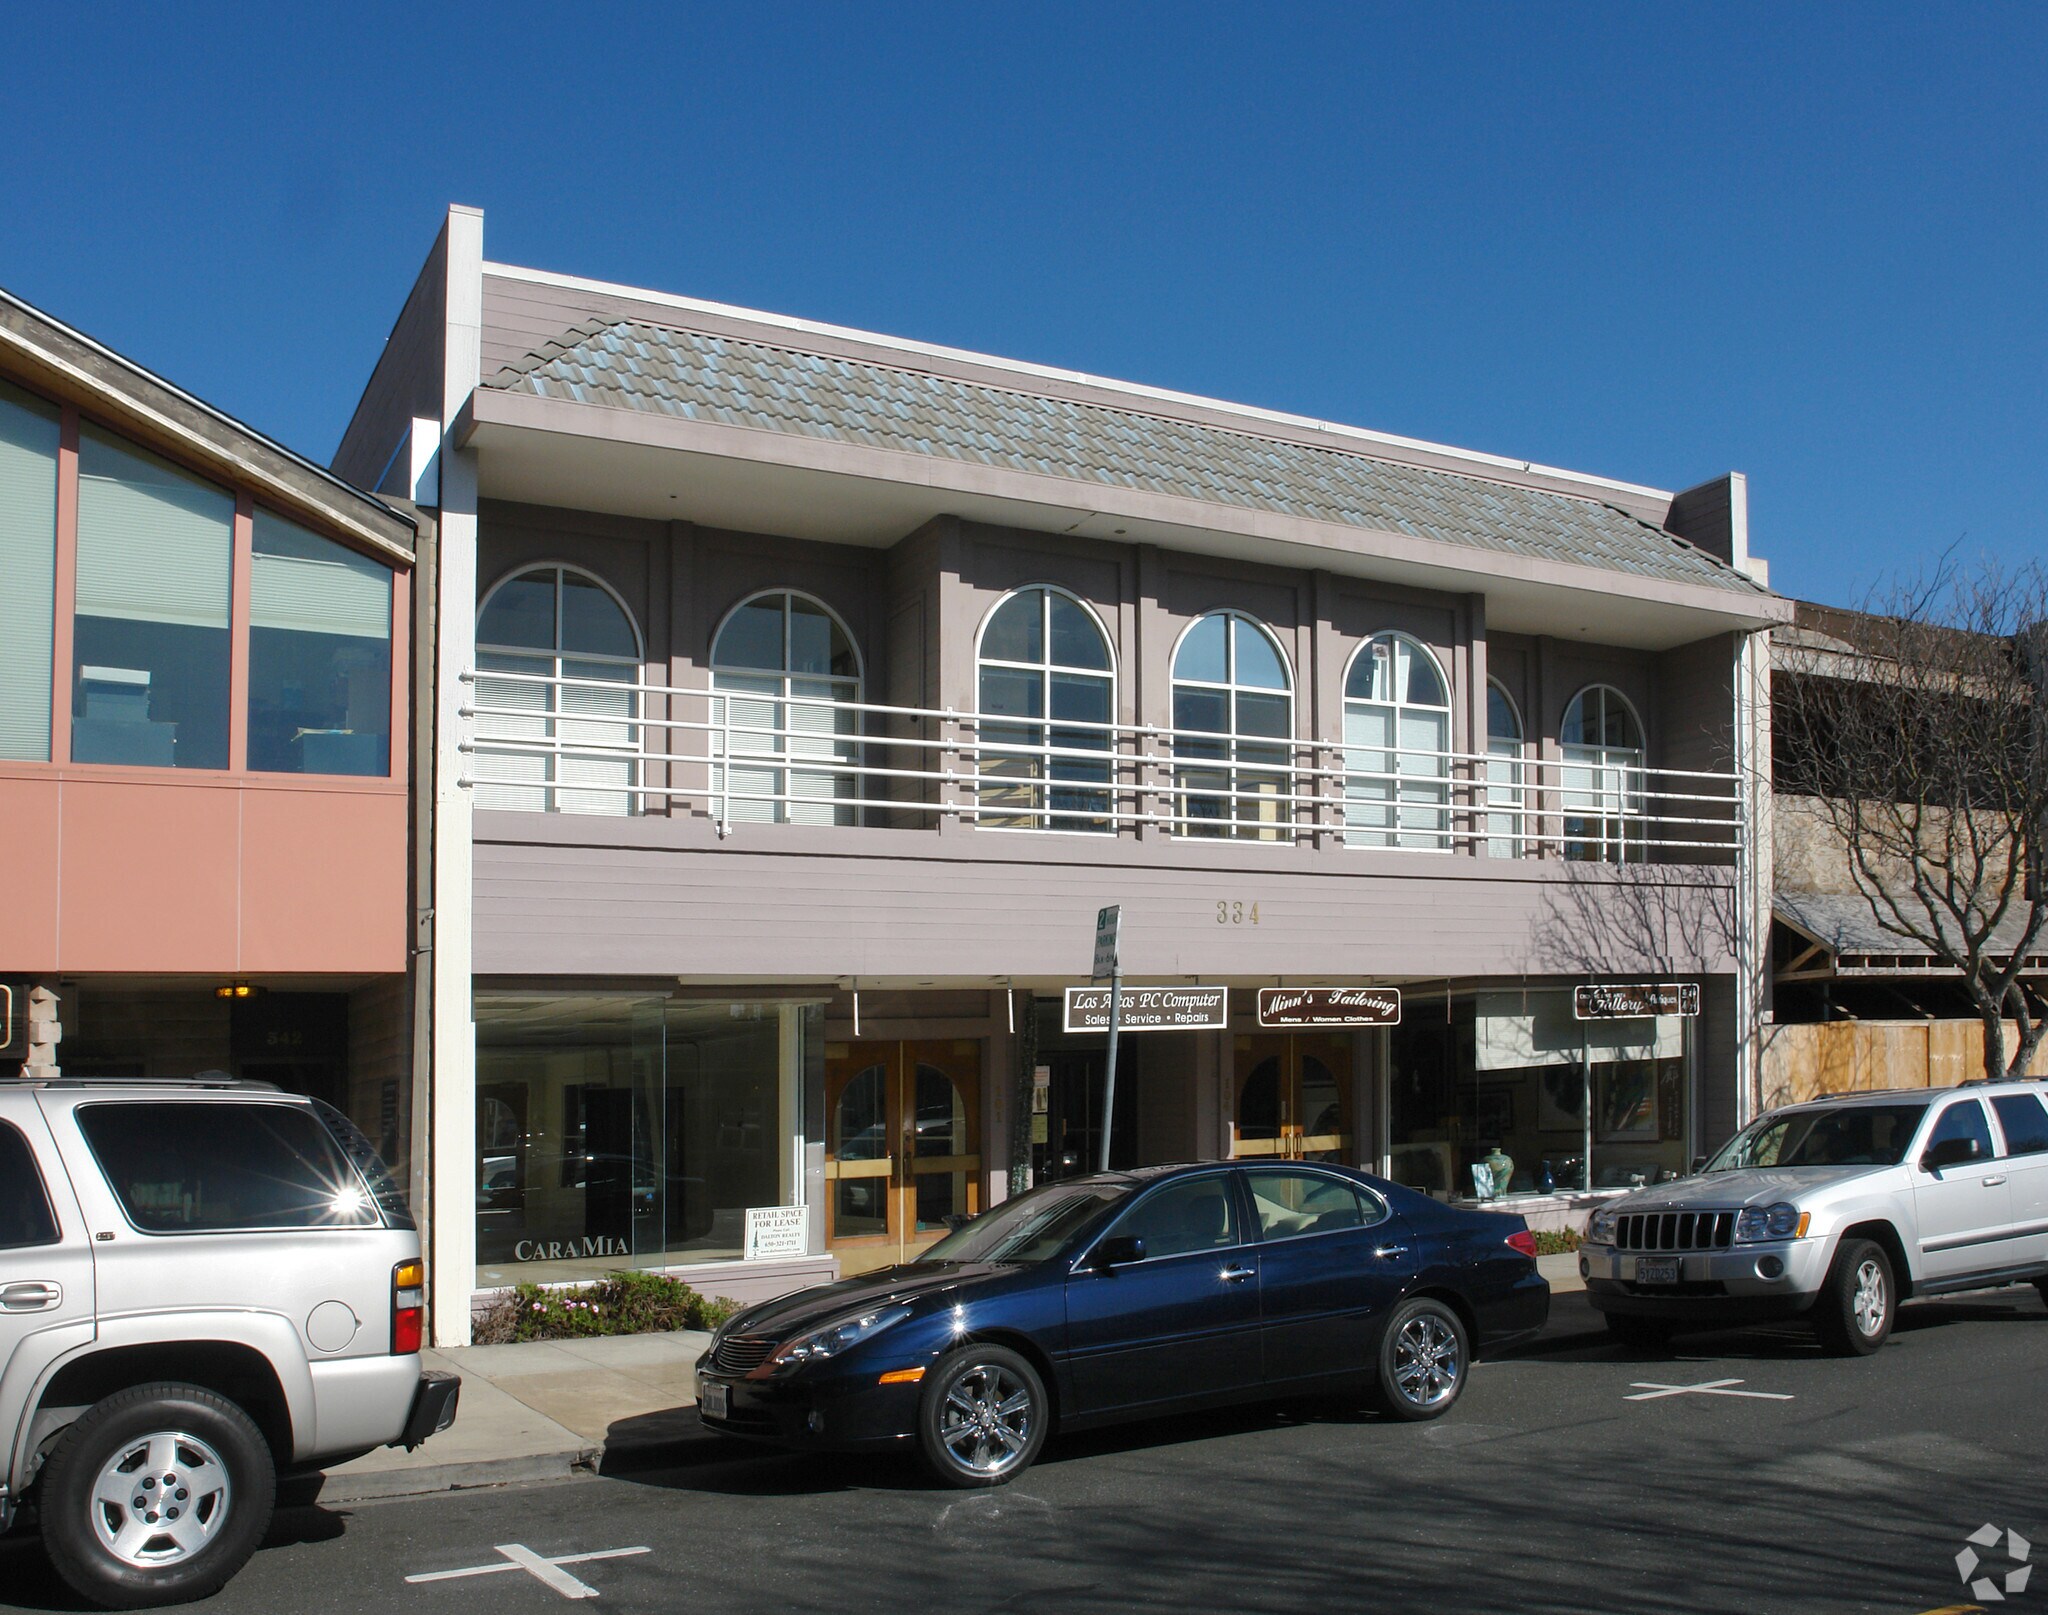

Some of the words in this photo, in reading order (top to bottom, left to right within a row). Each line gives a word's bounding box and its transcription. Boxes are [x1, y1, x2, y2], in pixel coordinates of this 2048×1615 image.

[1216, 900, 1260, 925] 334
[1073, 993, 1098, 1010] Los
[1139, 992, 1160, 1008] PC
[1162, 992, 1221, 1013] Computer
[1262, 990, 1314, 1017] Minn's
[1328, 989, 1397, 1017] Tailoring
[1589, 987, 1645, 1014] Gallery
[1085, 1014, 1111, 1025] Sales
[1125, 1013, 1162, 1024] Service
[1174, 1012, 1209, 1024] Repairs
[753, 1211, 779, 1219] RETAIL
[755, 1220, 771, 1228] FOR
